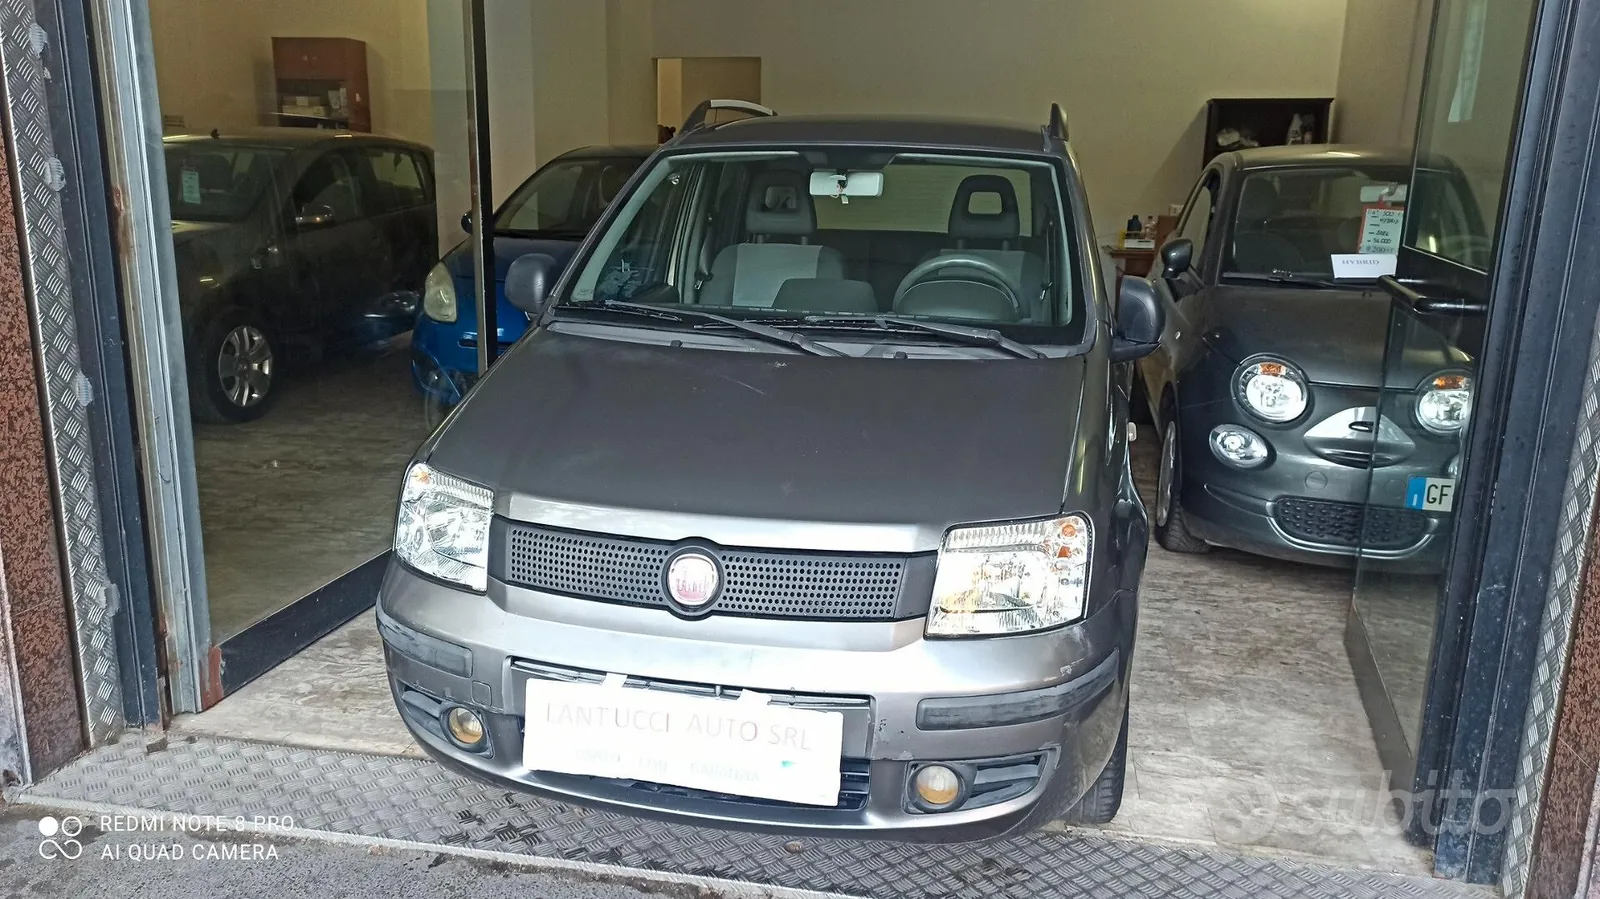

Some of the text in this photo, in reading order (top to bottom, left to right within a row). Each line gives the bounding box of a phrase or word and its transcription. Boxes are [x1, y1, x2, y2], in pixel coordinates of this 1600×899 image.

[1426, 484, 1452, 505] GF
[546, 702, 812, 751] LANTUCCI AUTO SRL
